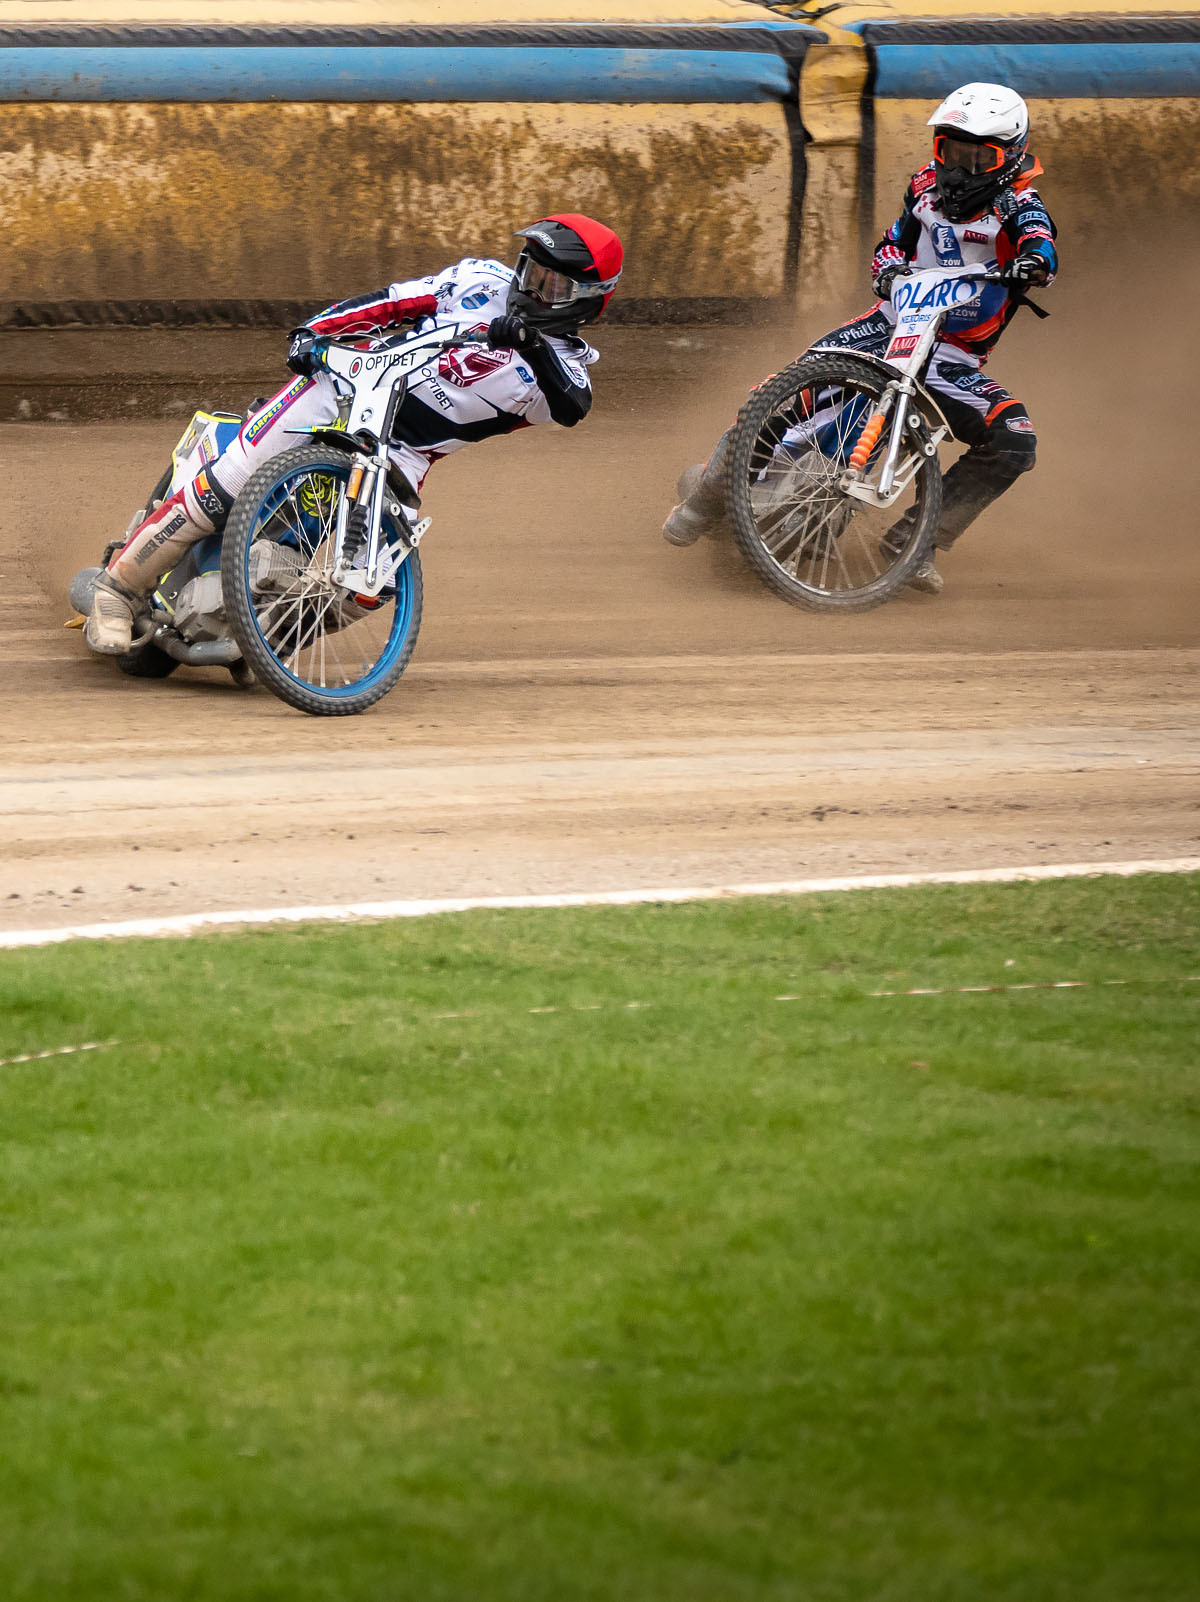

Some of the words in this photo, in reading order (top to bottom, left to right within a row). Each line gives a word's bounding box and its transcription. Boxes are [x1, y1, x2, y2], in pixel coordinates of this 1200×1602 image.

[365, 352, 417, 371] OPTIBET
[248, 402, 283, 438] CARPETS
[291, 377, 309, 396] LESS
[421, 367, 455, 411] OPTIBET
[154, 514, 188, 545] STUDIOS
